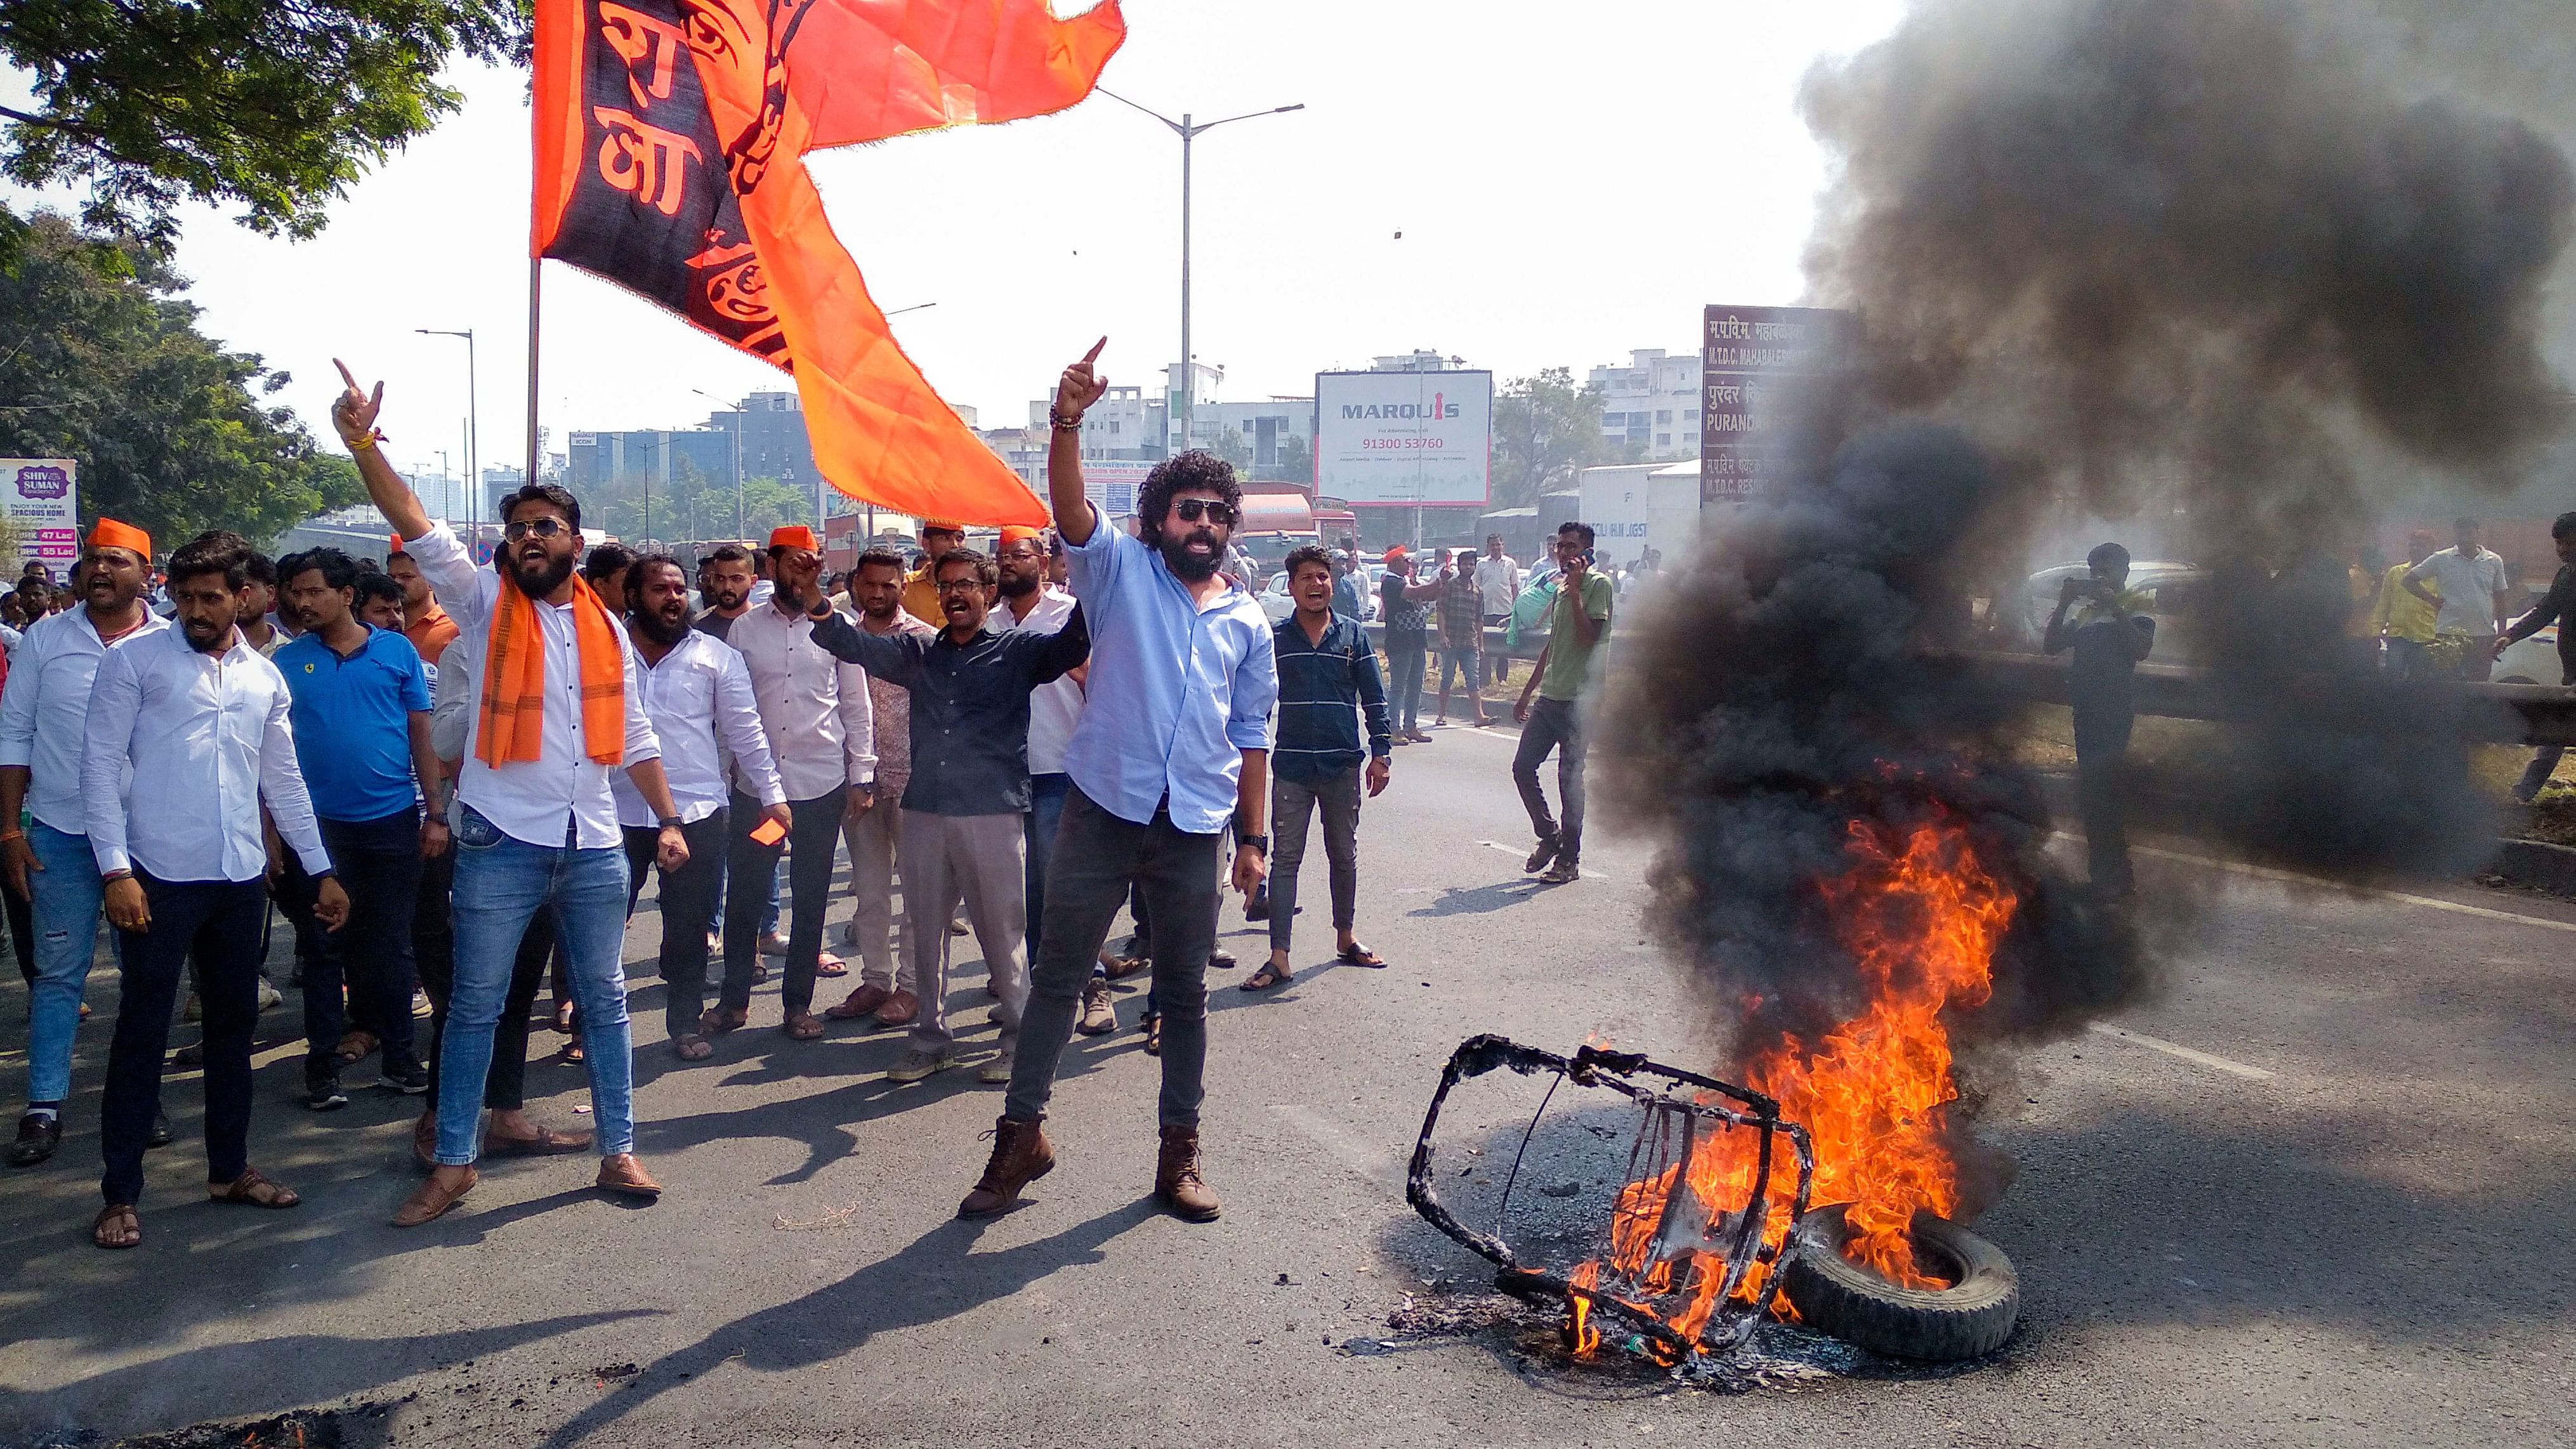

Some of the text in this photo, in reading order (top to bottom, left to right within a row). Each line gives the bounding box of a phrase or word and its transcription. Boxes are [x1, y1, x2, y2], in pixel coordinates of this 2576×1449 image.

[1709, 347, 1738, 365] M.T.D.C.
[1707, 381, 1740, 410] पुरंदर
[1342, 391, 1459, 420] MARQUIS
[1363, 438, 1443, 449] 91300 53760
[23, 471, 48, 480] SHIV
[24, 481, 60, 490] SUMAN
